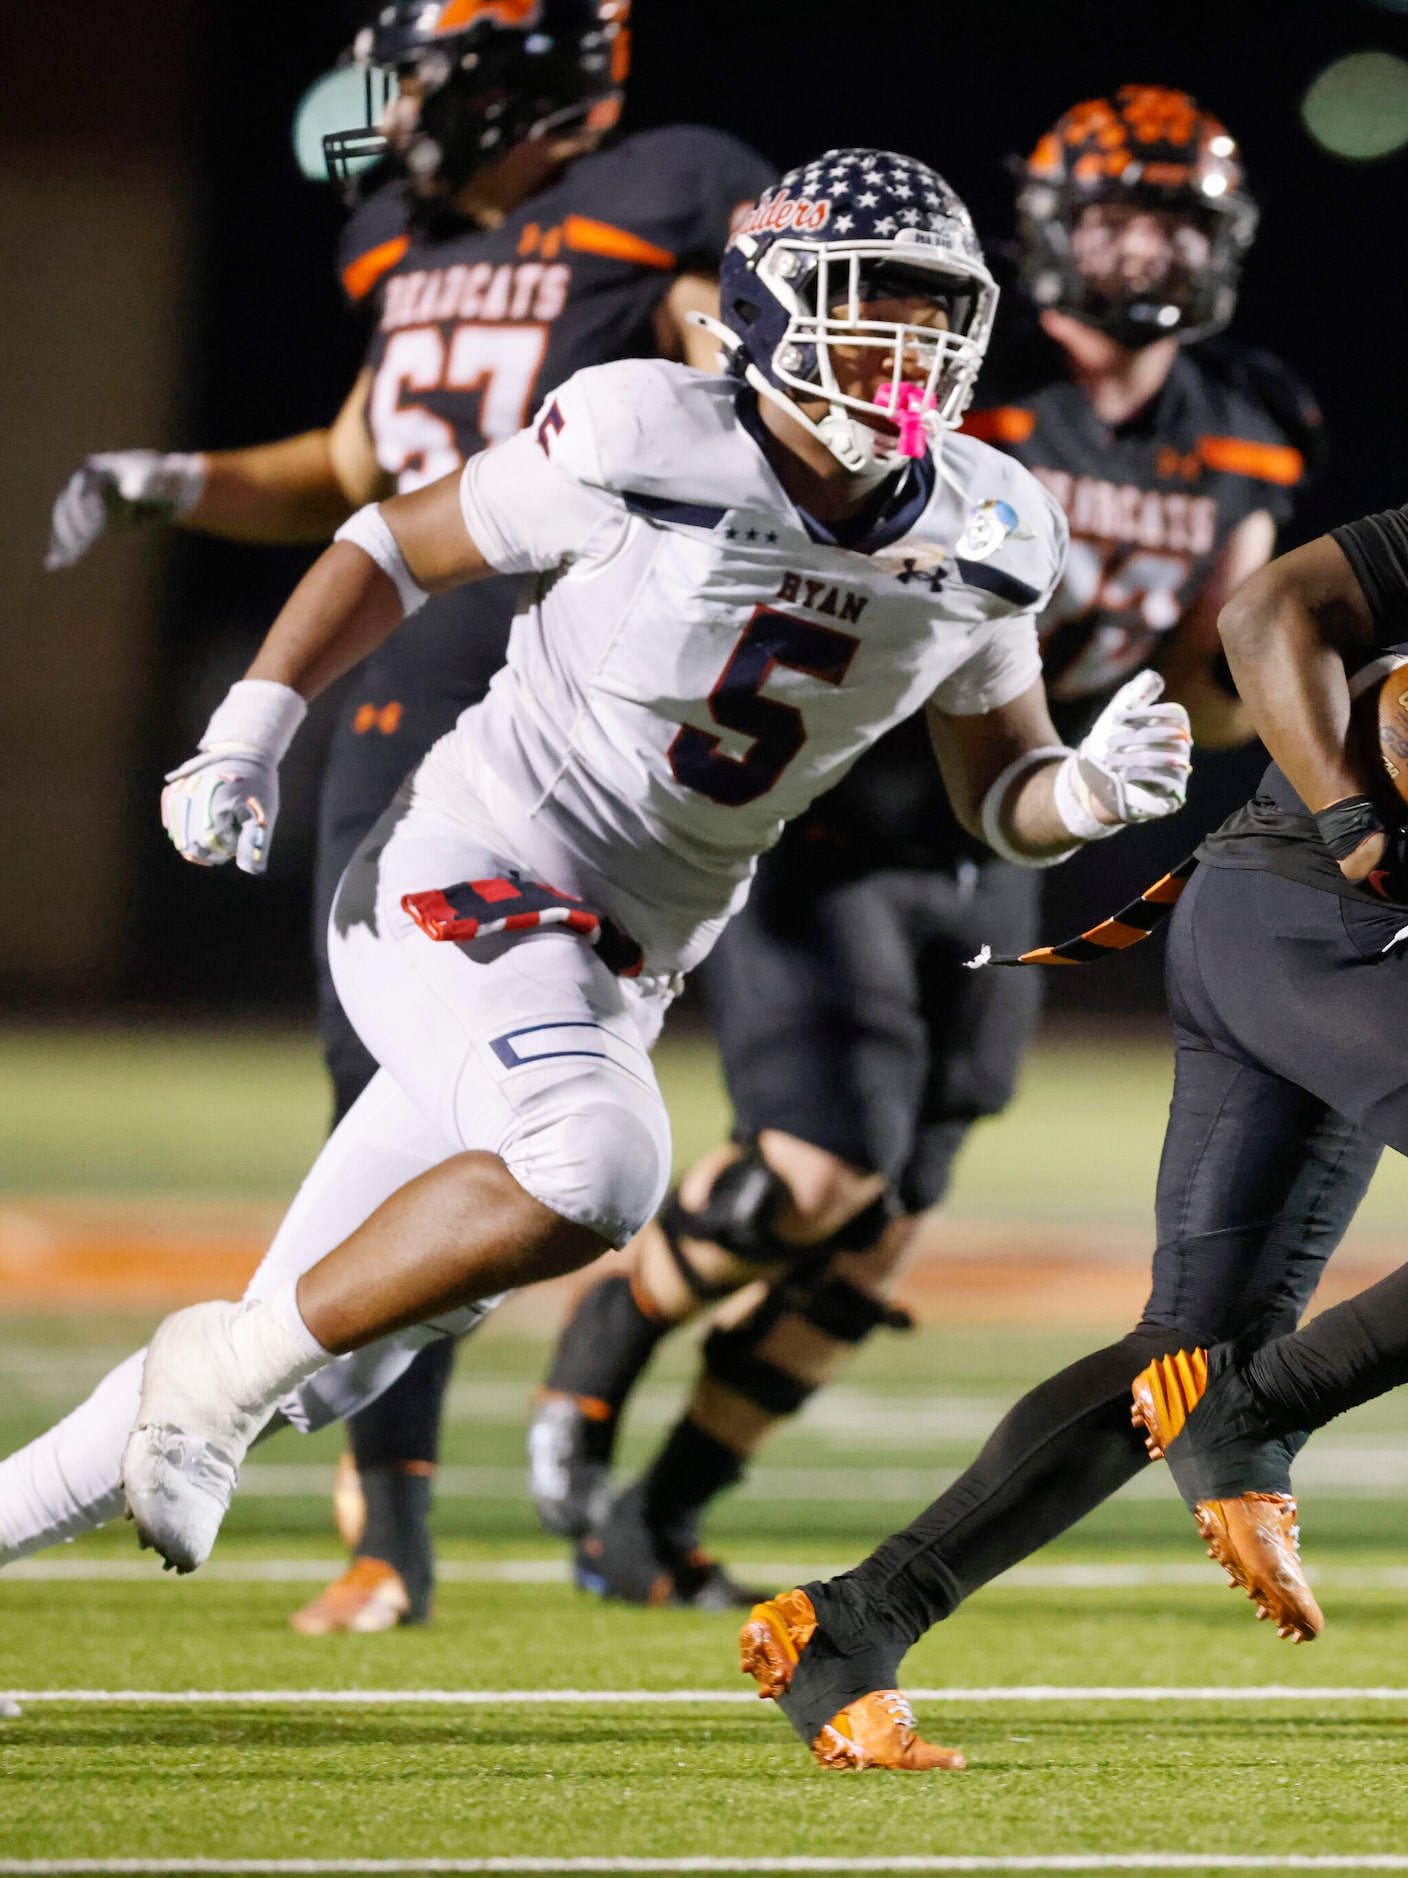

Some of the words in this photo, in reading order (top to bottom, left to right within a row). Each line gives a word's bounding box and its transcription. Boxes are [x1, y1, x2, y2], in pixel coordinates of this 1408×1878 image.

[370, 319, 549, 495] 67
[776, 571, 869, 624] RYAN
[668, 602, 861, 808] 5
